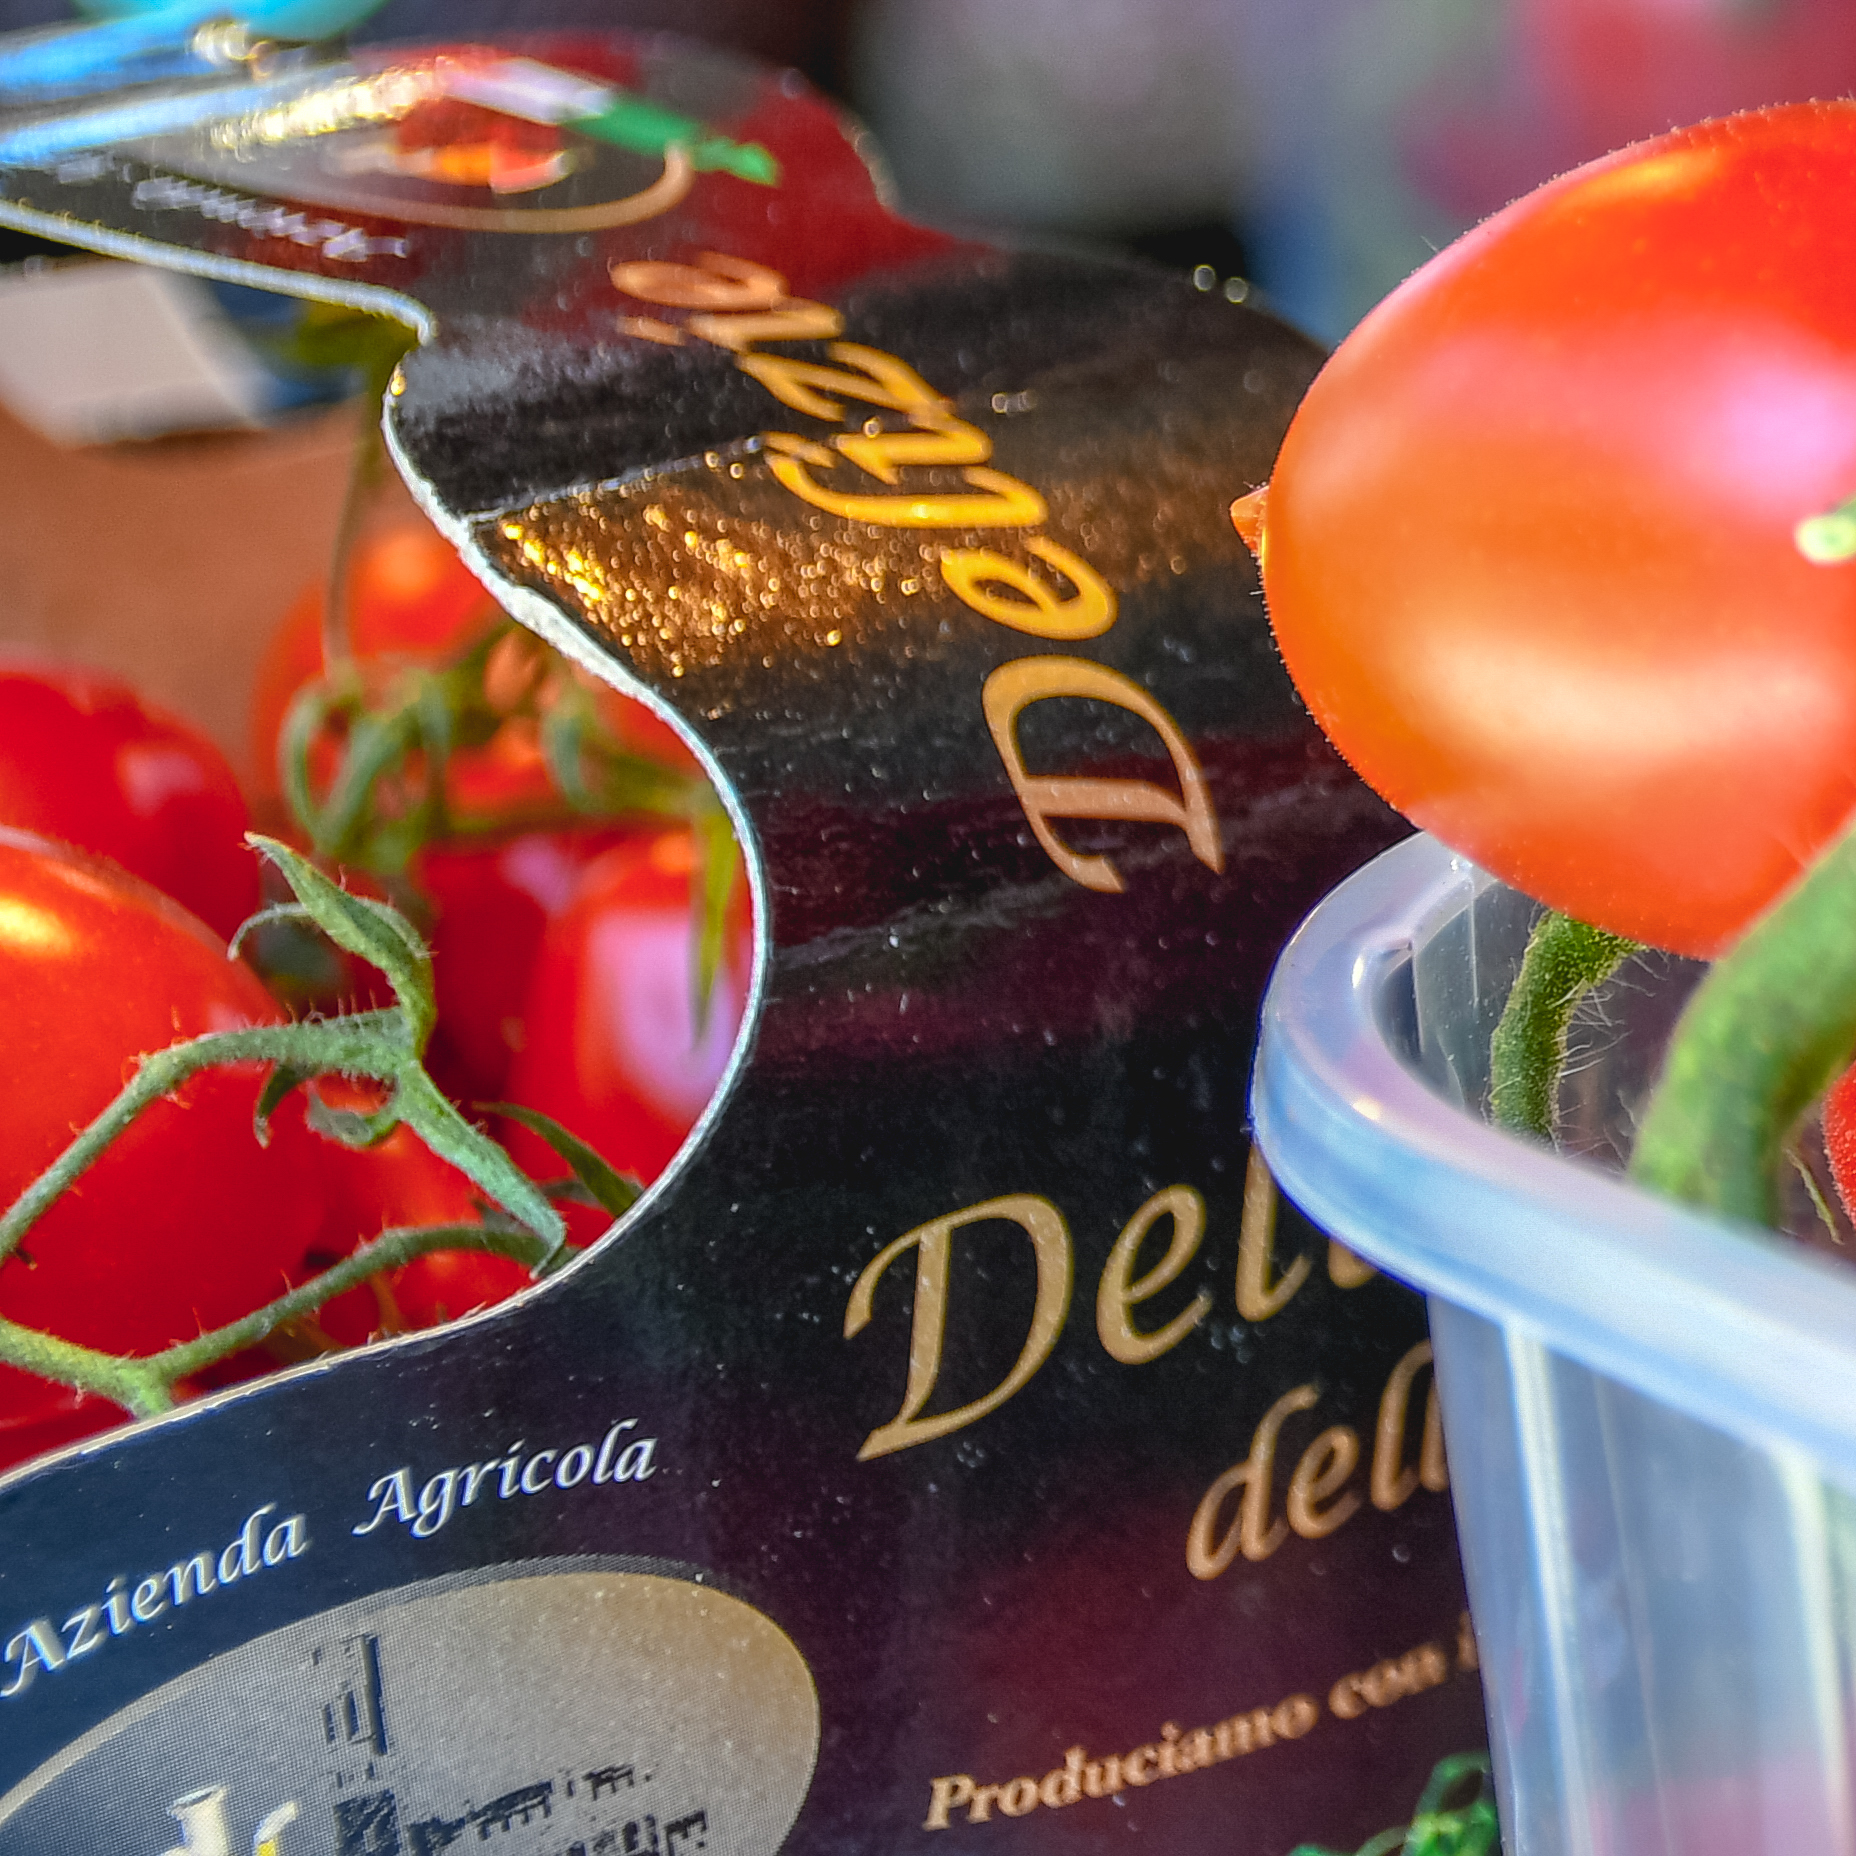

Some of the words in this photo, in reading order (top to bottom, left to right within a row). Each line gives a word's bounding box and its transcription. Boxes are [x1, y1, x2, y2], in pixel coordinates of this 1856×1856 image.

[611, 251, 1225, 892] Delizie
[843, 1141, 1378, 1462] Del
[0, 1504, 311, 1698] Azienda
[352, 1418, 657, 1539] Agricola
[923, 1693, 1319, 1831] Produciamo
[1328, 1644, 1446, 1720] con
